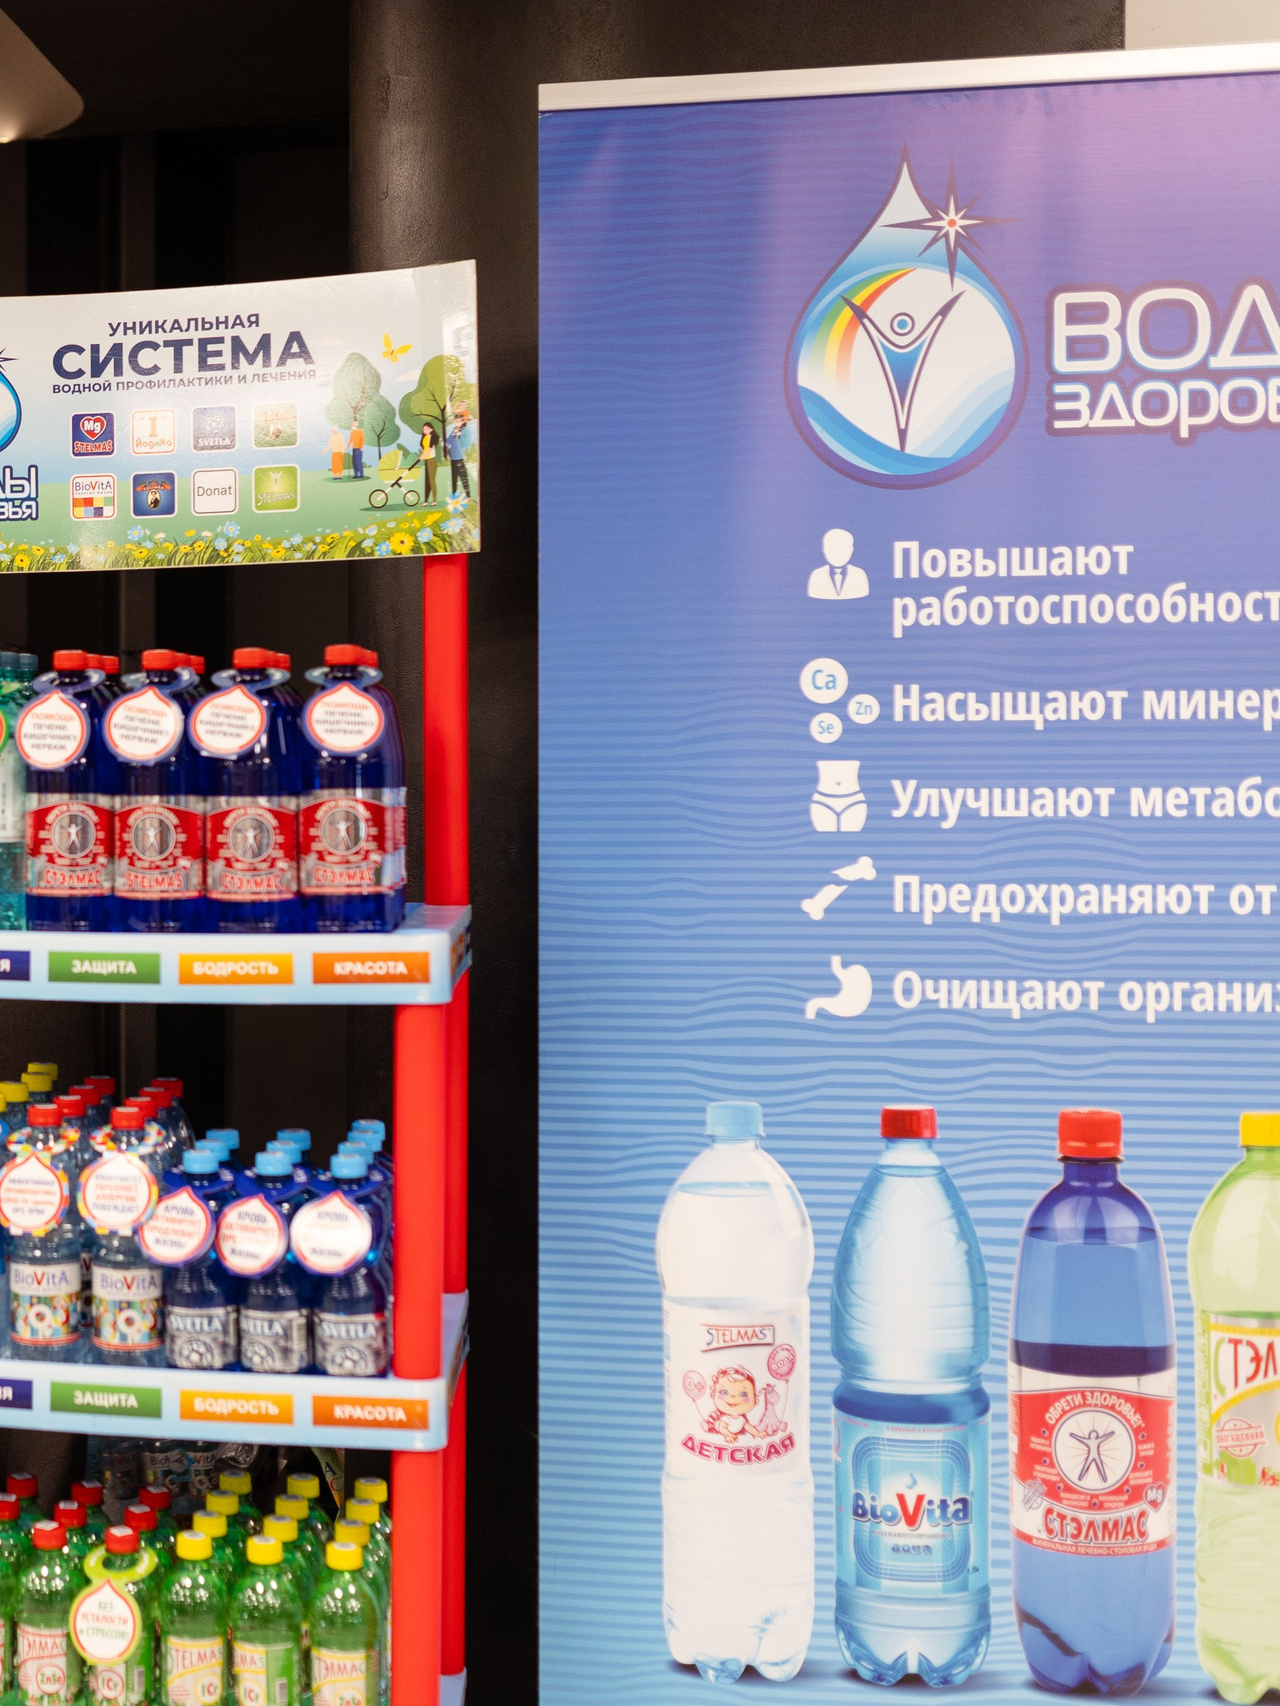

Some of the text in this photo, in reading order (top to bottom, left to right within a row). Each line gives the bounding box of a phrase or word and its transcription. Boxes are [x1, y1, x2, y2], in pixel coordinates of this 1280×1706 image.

[107, 313, 260, 338] УНИКАЛЬНАЯ
[52, 330, 316, 377] СИСТЕМА
[52, 369, 317, 395] ВОДНОЙ ПРОФИЛАКТИКИ И ЛЕЧЕНИЯ
[84, 420, 101, 433] Mg
[74, 440, 113, 453] STELMAS
[198, 438, 231, 447] SVETLA
[75, 481, 112, 491] BioVitA
[197, 486, 232, 497] Donat
[257, 491, 295, 506] STELMAS
[894, 541, 1134, 579] Повышают
[893, 583, 1280, 638] работоспособност
[811, 669, 837, 691] Ca
[855, 701, 873, 715] Zn
[893, 684, 1280, 731] Насыщают минер
[817, 720, 834, 735] Se
[891, 779, 1115, 829] Улучшают
[45, 869, 101, 887] СТЭЛМАС
[127, 872, 183, 890] STELMAS
[894, 875, 1277, 926] Предохраняют от
[70, 958, 137, 976] ЗАЩИТА
[192, 960, 279, 977] БОДРОСТЬ
[333, 959, 408, 976] КРАСОТА
[894, 970, 1280, 1024] Очищают органи
[14, 1271, 70, 1287] BioVitA
[101, 1272, 158, 1291] BioVitA
[171, 1315, 222, 1333] SVETLA
[322, 1321, 376, 1339] SVETLA
[707, 1326, 767, 1346] STELMAS
[73, 1390, 139, 1410] ЗАЩИТА
[194, 1397, 279, 1417] БОДРОСТЬ
[333, 1403, 407, 1423] КРАСОТА
[1045, 1392, 1145, 1428] ОБРЕТИ ЗДОРОВЬЕ!
[681, 1433, 796, 1465] ДЕТСКАЯ
[1147, 1488, 1164, 1503] Mg
[852, 1491, 972, 1531] BioVita
[1042, 1505, 1149, 1545] СТЭЛМАС
[891, 1543, 933, 1556] aqua
